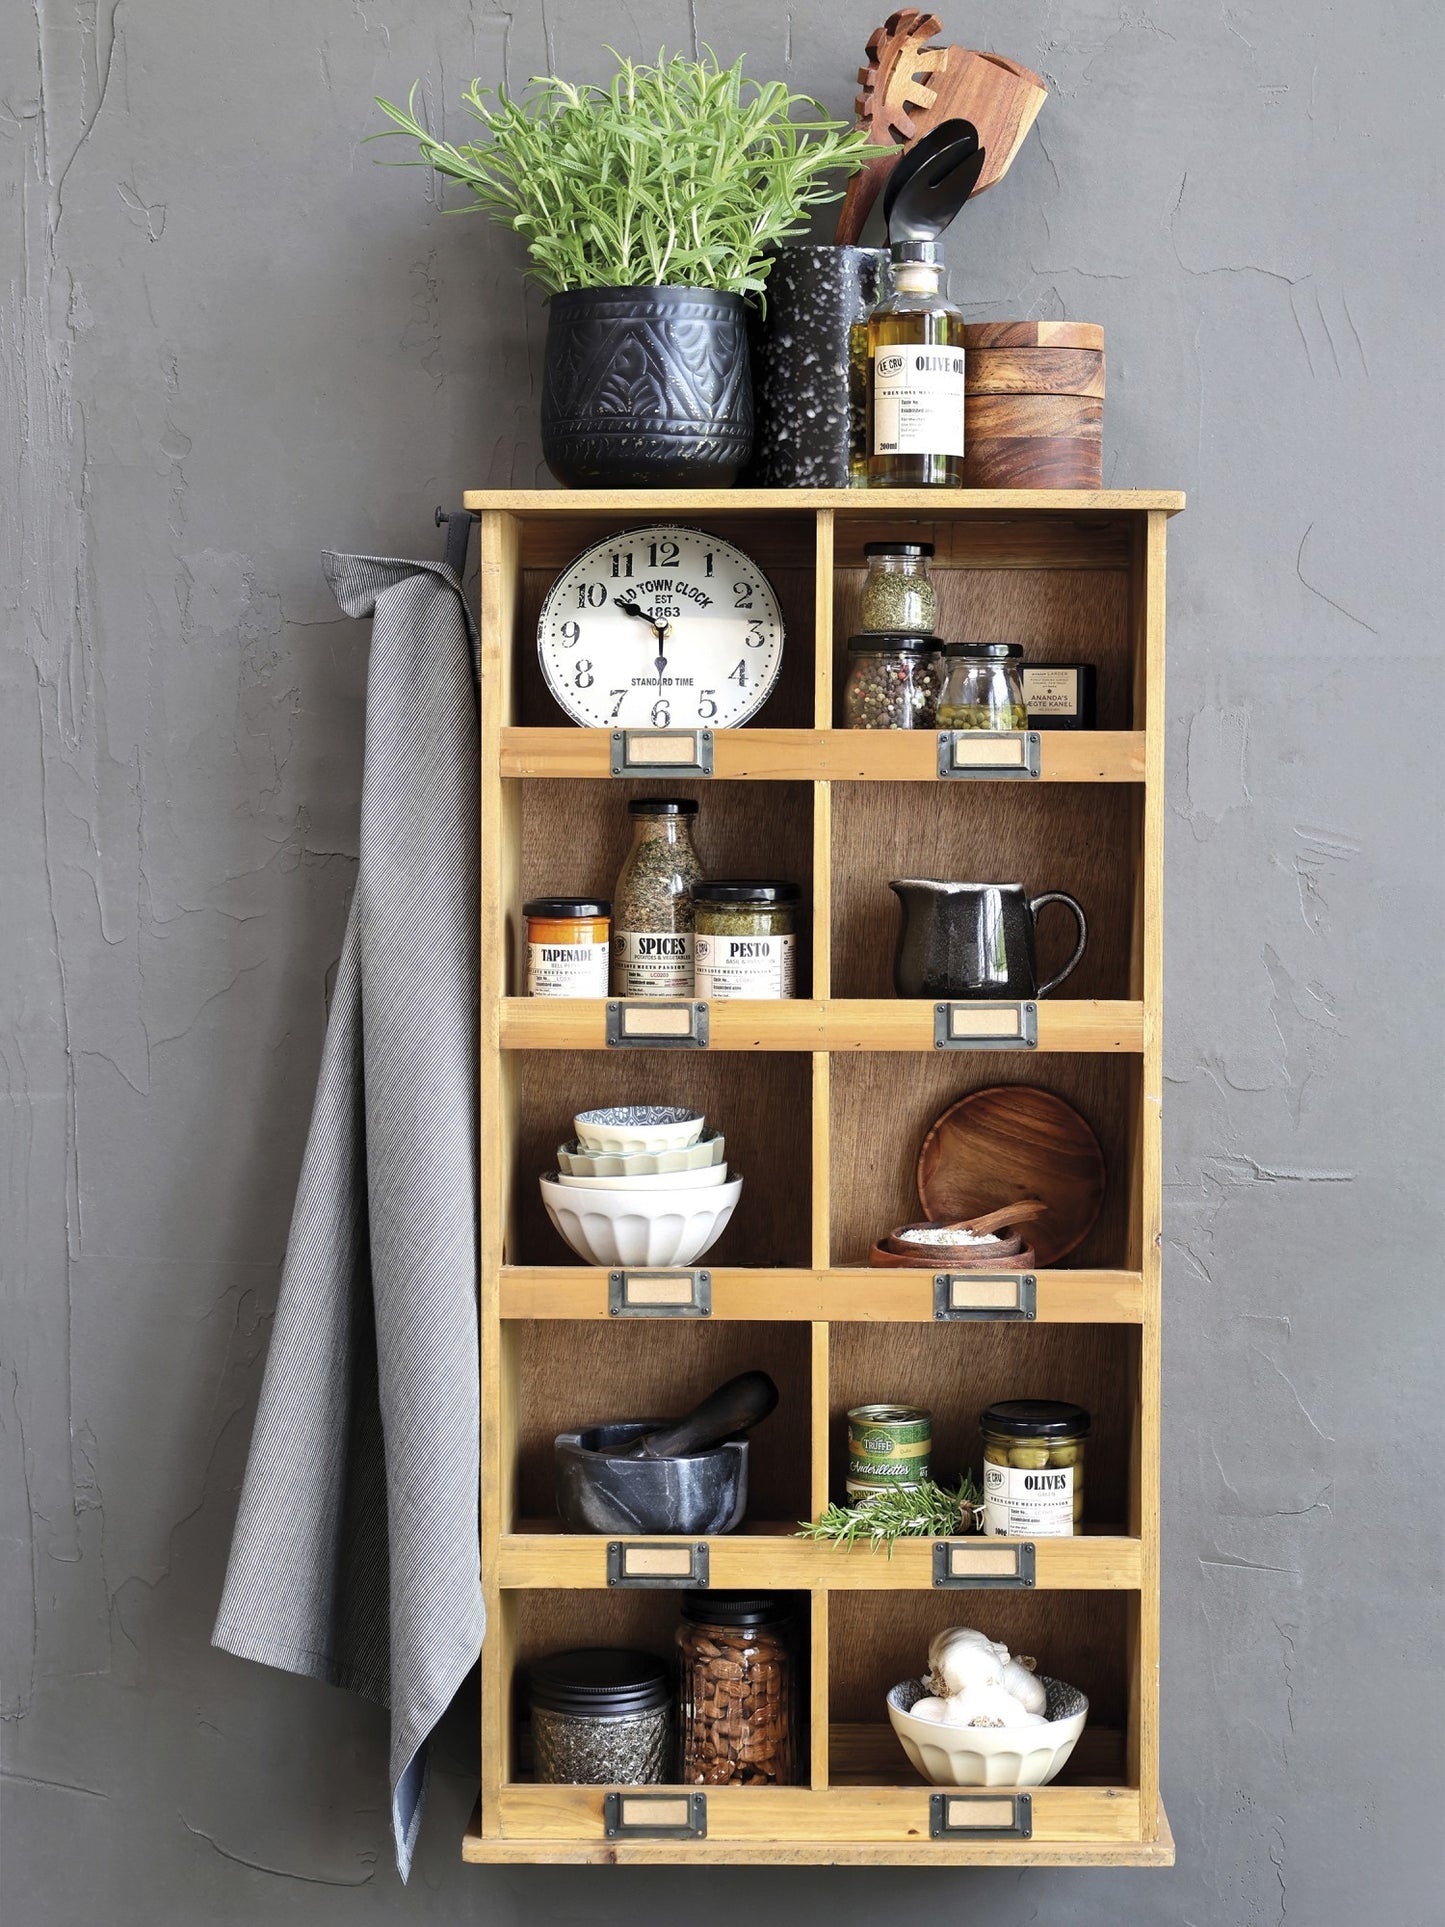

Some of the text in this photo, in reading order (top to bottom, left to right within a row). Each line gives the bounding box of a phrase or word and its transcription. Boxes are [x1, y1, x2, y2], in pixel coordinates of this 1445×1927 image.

[880, 361, 888, 372] LE
[889, 358, 903, 370] CRU
[916, 356, 951, 372] OLIVE
[880, 442, 898, 451] 200ml
[610, 552, 635, 578] 11
[647, 541, 681, 568] 12
[703, 552, 715, 577] 1
[576, 582, 608, 609] 10
[636, 579, 673, 596] TOWN
[675, 581, 714, 609] CLOCK
[655, 594, 674, 604] EST
[732, 582, 753, 609] 2
[647, 606, 681, 618] 1863
[560, 621, 581, 649] 9
[745, 619, 765, 648] 3
[574, 659, 594, 688] 8
[631, 677, 694, 687] STANDARD TIME
[728, 658, 749, 688] 4
[609, 689, 628, 717] 7
[651, 699, 671, 729] 6
[698, 689, 718, 719] 5
[541, 949, 593, 962] TAPENADE
[638, 938, 686, 955] SPICES
[730, 942, 770, 957] PESTO
[1024, 1474, 1066, 1490] OLIVES
